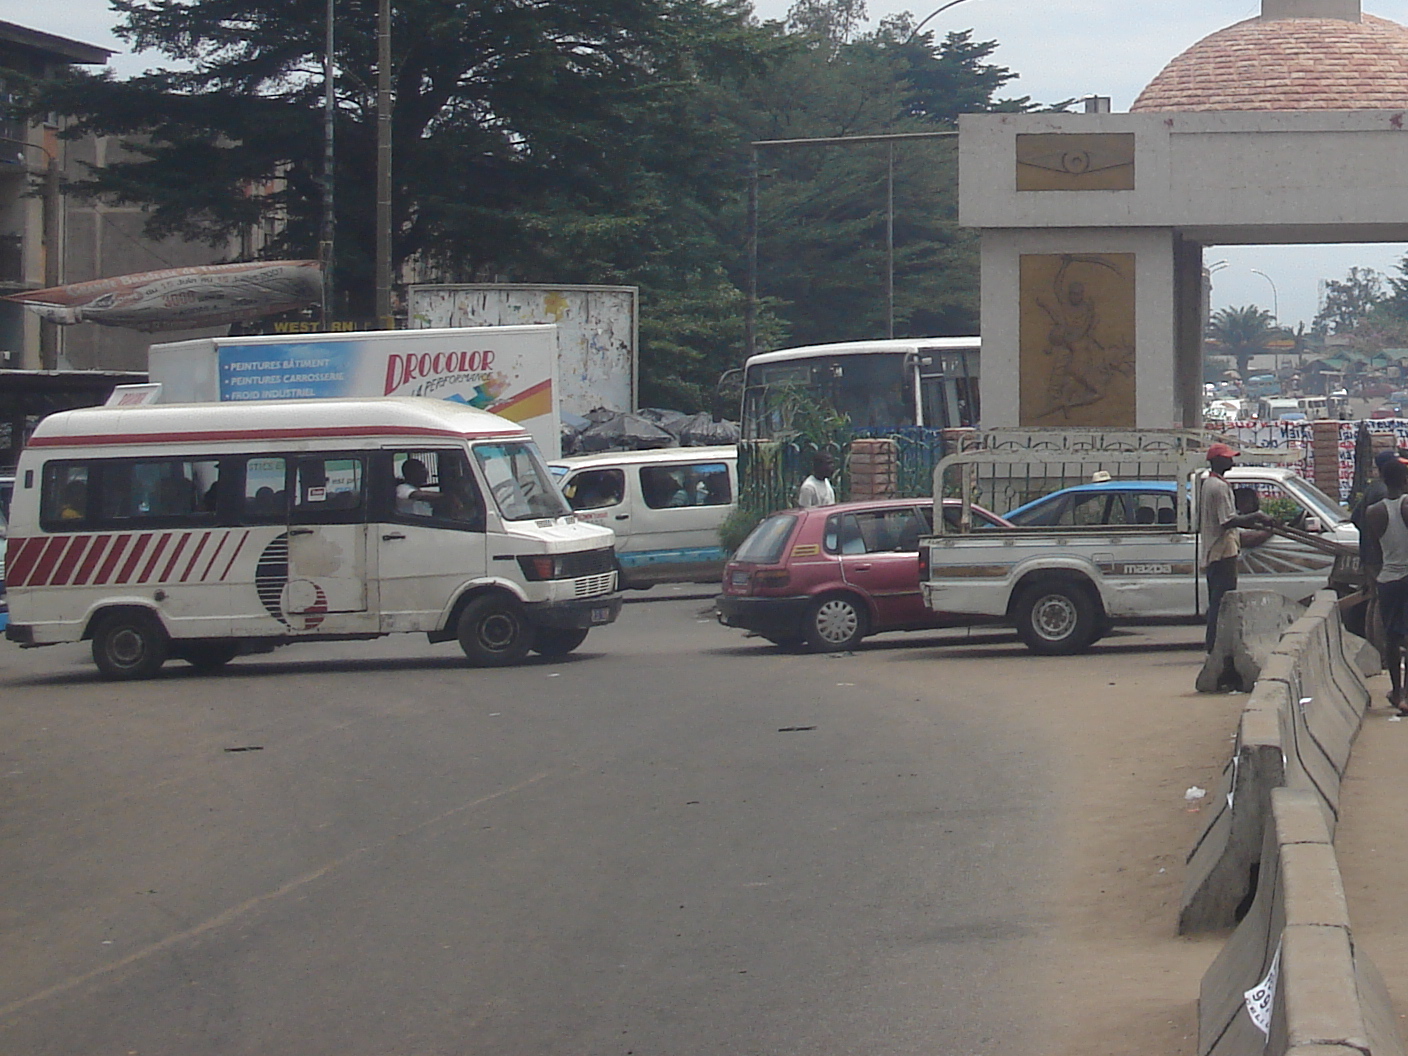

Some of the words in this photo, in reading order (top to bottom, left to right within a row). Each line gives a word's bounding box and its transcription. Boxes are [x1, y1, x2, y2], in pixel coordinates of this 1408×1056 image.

[230, 359, 281, 372] PEINTURES
[283, 357, 331, 370] BÂTIMENT
[231, 374, 282, 386] PEINTURES
[283, 372, 345, 384] CARROSSERIE
[384, 350, 496, 397] DROCOLOR
[261, 387, 316, 400] INDUSTRIEL
